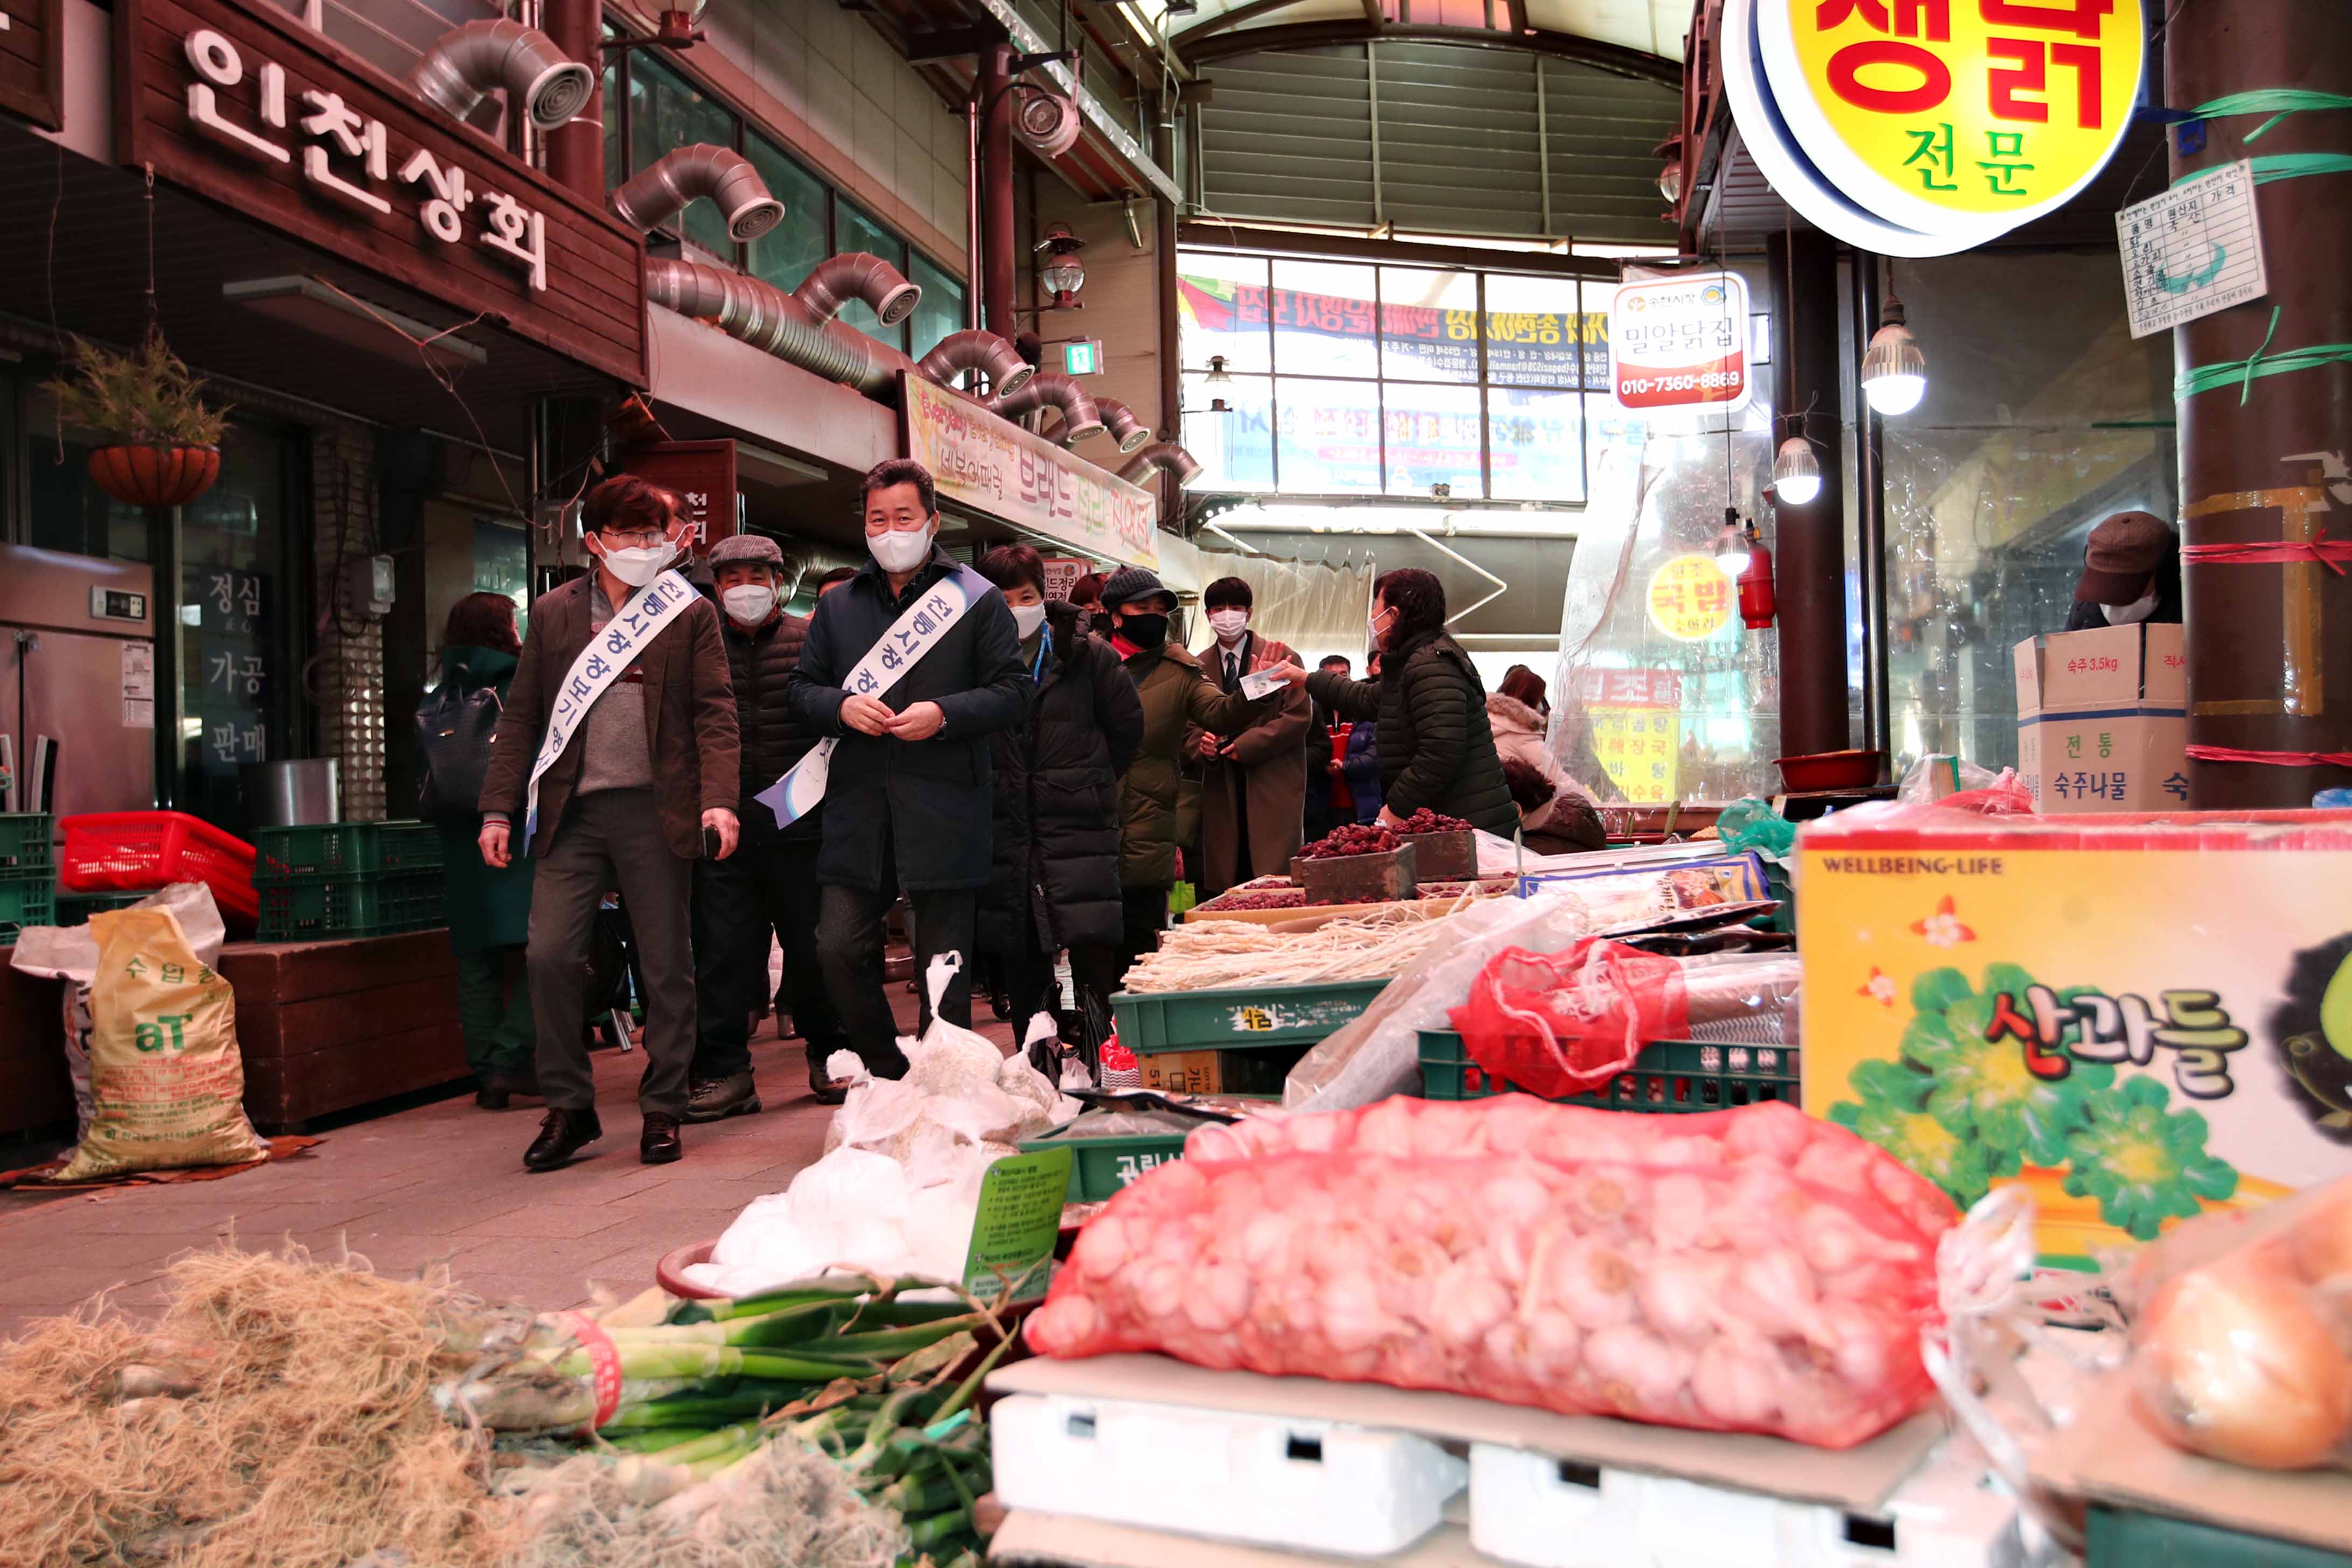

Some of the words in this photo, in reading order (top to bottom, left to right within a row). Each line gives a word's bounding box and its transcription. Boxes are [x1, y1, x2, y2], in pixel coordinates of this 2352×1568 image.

[184, 29, 547, 292] 인천상회
[1902, 123, 2035, 197] 전문
[2167, 200, 2197, 219] 원산지
[2211, 184, 2235, 202] 가격
[1648, 293, 1695, 308] 송현시장
[1625, 317, 1732, 354] 밀알닭집
[1621, 370, 1740, 395] 010-7360-8869
[1018, 441, 1073, 518] 브랜드
[210, 572, 262, 617] 정심
[607, 578, 685, 654] 전통시장
[881, 594, 953, 670] 전통시장
[209, 651, 267, 695] 가공
[2067, 657, 2087, 673] 숙주
[2090, 656, 2118, 673] 3.5kg
[559, 653, 612, 727] 장보기
[213, 722, 266, 762] 판매
[2066, 732, 2113, 760] 전통
[2053, 772, 2127, 801] 숙주나물
[1823, 857, 2004, 877] WELLBEING-LIFE
[135, 1013, 193, 1052] aT
[1984, 983, 2249, 1100] 산과들
